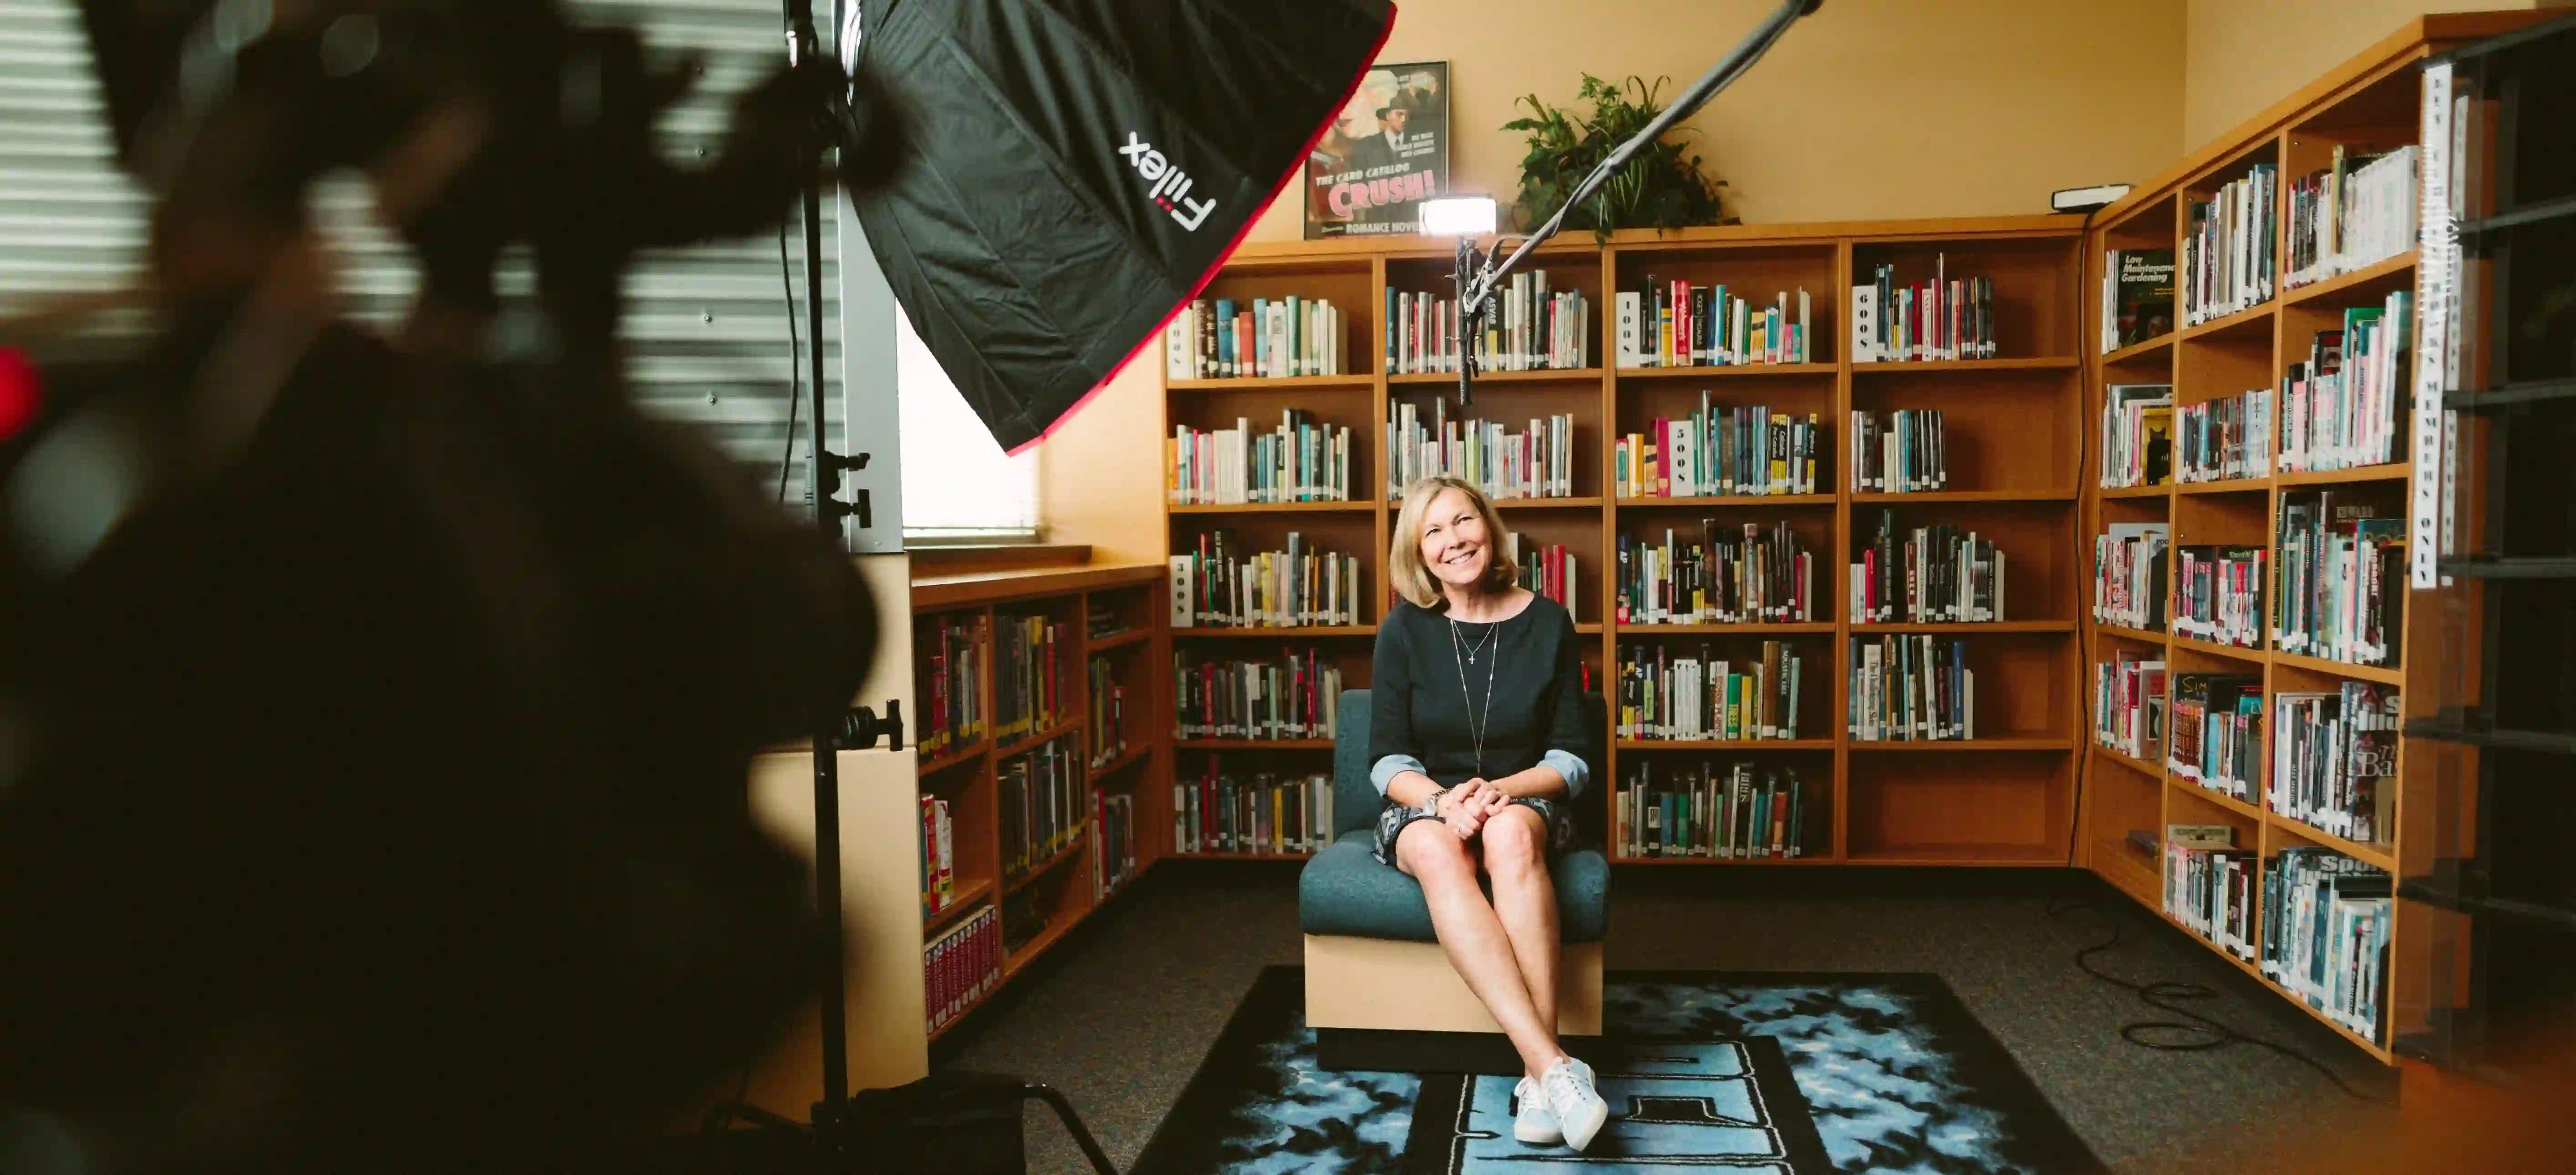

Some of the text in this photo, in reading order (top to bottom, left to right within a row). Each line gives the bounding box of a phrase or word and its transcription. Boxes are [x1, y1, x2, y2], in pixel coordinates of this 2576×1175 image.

[1118, 131, 1216, 231] Fiilex
[1316, 163, 1410, 186] THE CARD CATALOG
[1328, 170, 1436, 218] CRUSH!
[1346, 222, 1389, 234] ROMANCE
[2125, 255, 2143, 265] Low
[2122, 273, 2167, 283] Gardening
